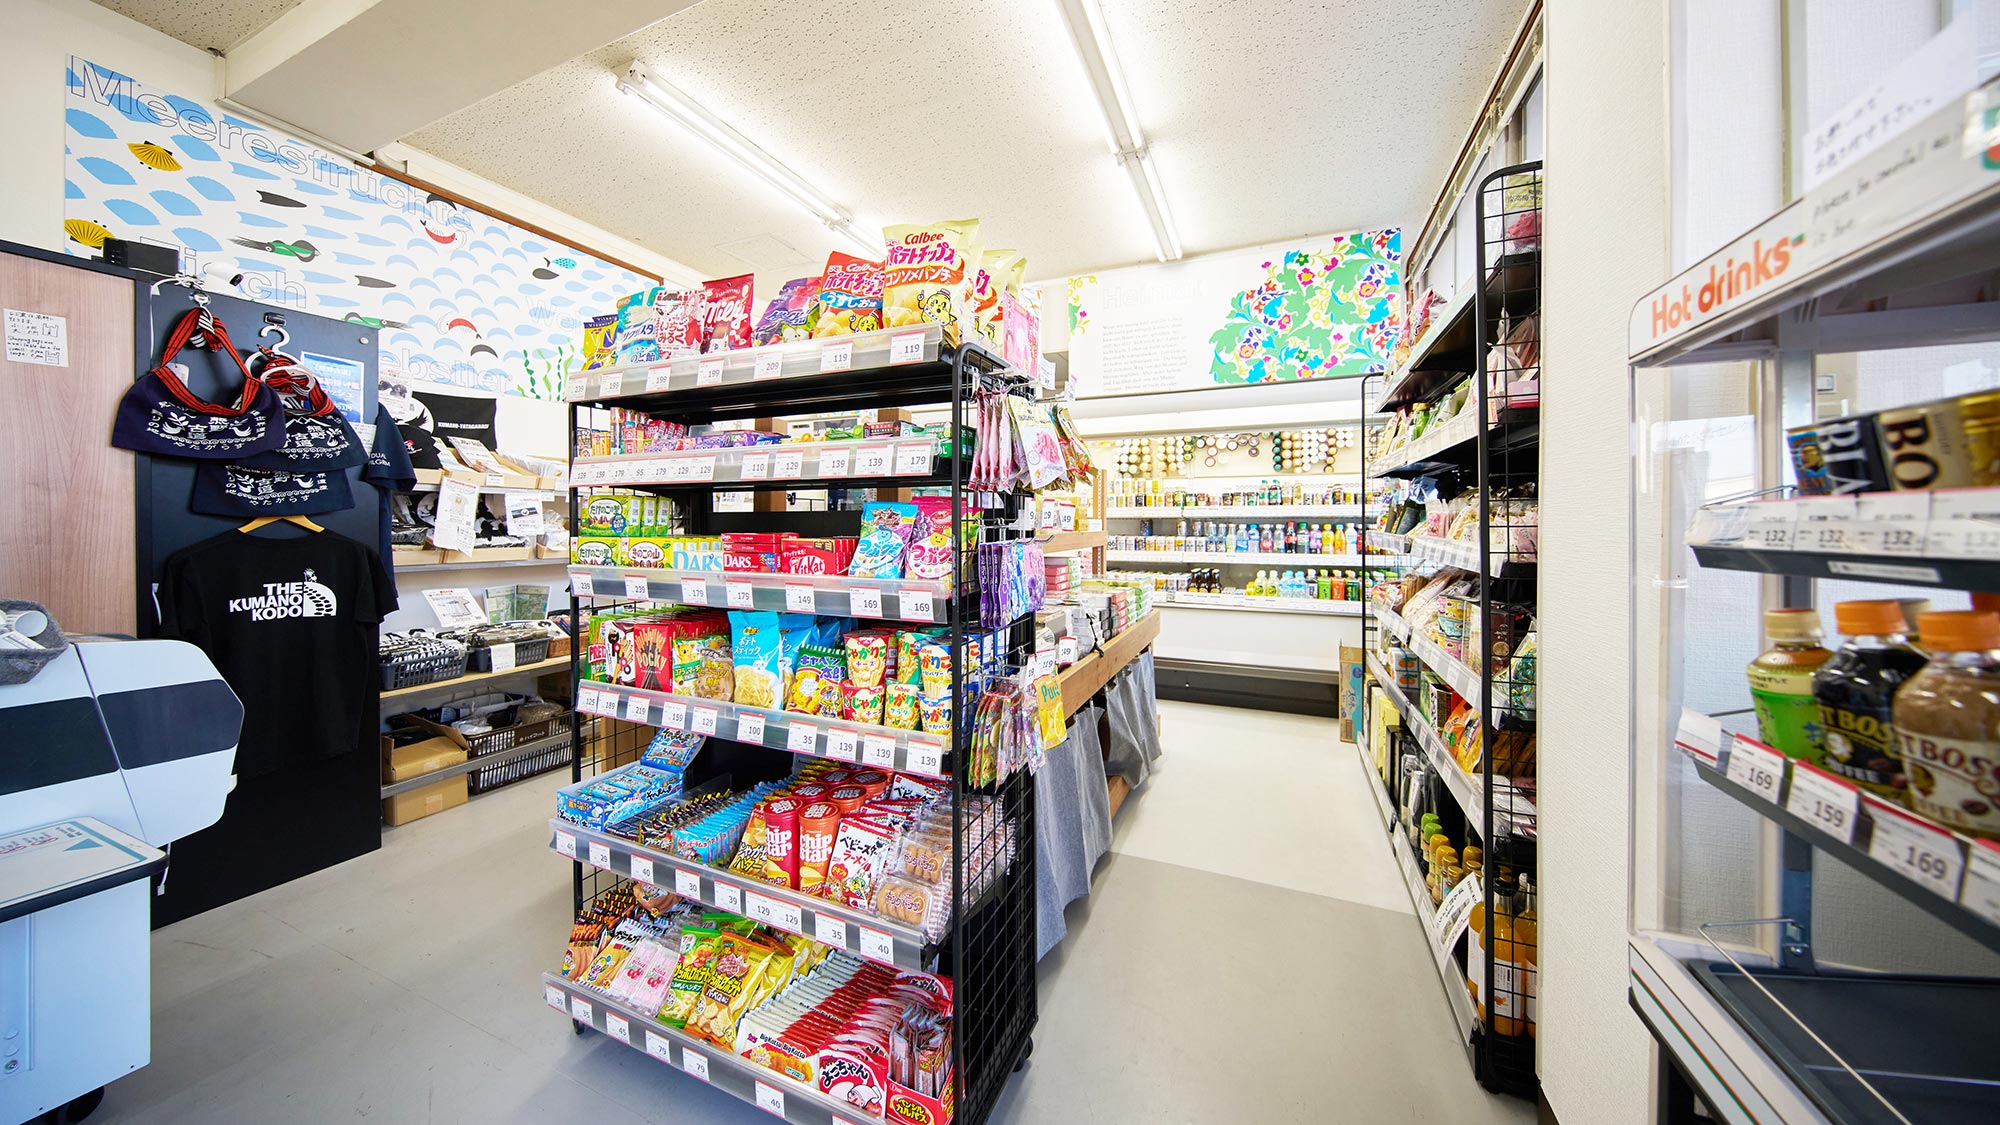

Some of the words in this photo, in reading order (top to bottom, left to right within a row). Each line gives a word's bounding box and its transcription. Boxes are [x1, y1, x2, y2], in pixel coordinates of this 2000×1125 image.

[904, 230, 945, 246] Calbee
[885, 269, 951, 287] コンソメパンチ
[1651, 284, 1692, 338] Hot
[1697, 235, 1792, 314] drinks
[903, 344, 921, 355] 119
[833, 353, 848, 363] 119
[765, 361, 780, 371] 209
[707, 369, 720, 379] 199
[655, 375, 668, 385] 199
[785, 461, 799, 471] 129
[831, 459, 846, 469] 139
[868, 457, 883, 468] 139
[910, 456, 926, 466] 179
[655, 467, 667, 476] 179
[677, 466, 690, 476] 129
[700, 465, 712, 475] 129
[751, 463, 765, 472] 110
[1764, 530, 1786, 543] 132
[1818, 529, 1845, 543] 132
[1882, 530, 1915, 546] 132
[723, 553, 751, 568] DARS
[263, 582, 303, 596] THE
[580, 582, 591, 590] 239
[634, 585, 646, 594] 239
[691, 589, 704, 598] 179
[736, 591, 750, 601] 179
[229, 594, 303, 612] KUMANO
[797, 595, 812, 605] 149
[862, 599, 878, 609] 169
[252, 605, 303, 621] KODO
[913, 602, 930, 613] 169
[739, 637, 757, 646] ポテト
[734, 645, 761, 656] スティック
[800, 655, 842, 665] キャベツ
[820, 666, 847, 680] 太郎
[635, 706, 646, 715] 219
[671, 713, 683, 723] 159
[701, 717, 714, 727] 129
[747, 725, 762, 736] 100
[801, 735, 813, 745] 35
[838, 741, 854, 752] 139
[875, 748, 891, 759] 139
[920, 755, 937, 767] 139
[1747, 766, 1774, 791] 169
[1814, 799, 1845, 829] 159
[733, 857, 763, 873] バター
[1905, 845, 1948, 881] 169
[688, 882, 698, 893] 30
[728, 895, 738, 905] 39
[756, 905, 771, 917] 129
[784, 913, 799, 926] 129
[831, 928, 843, 941] 35
[877, 943, 890, 955] 40
[658, 1045, 668, 1056] 79
[696, 1063, 706, 1074] 79
[821, 1060, 869, 1087] よっちゃん
[770, 1097, 781, 1109] 40
[897, 1097, 925, 1114] ペンシル
